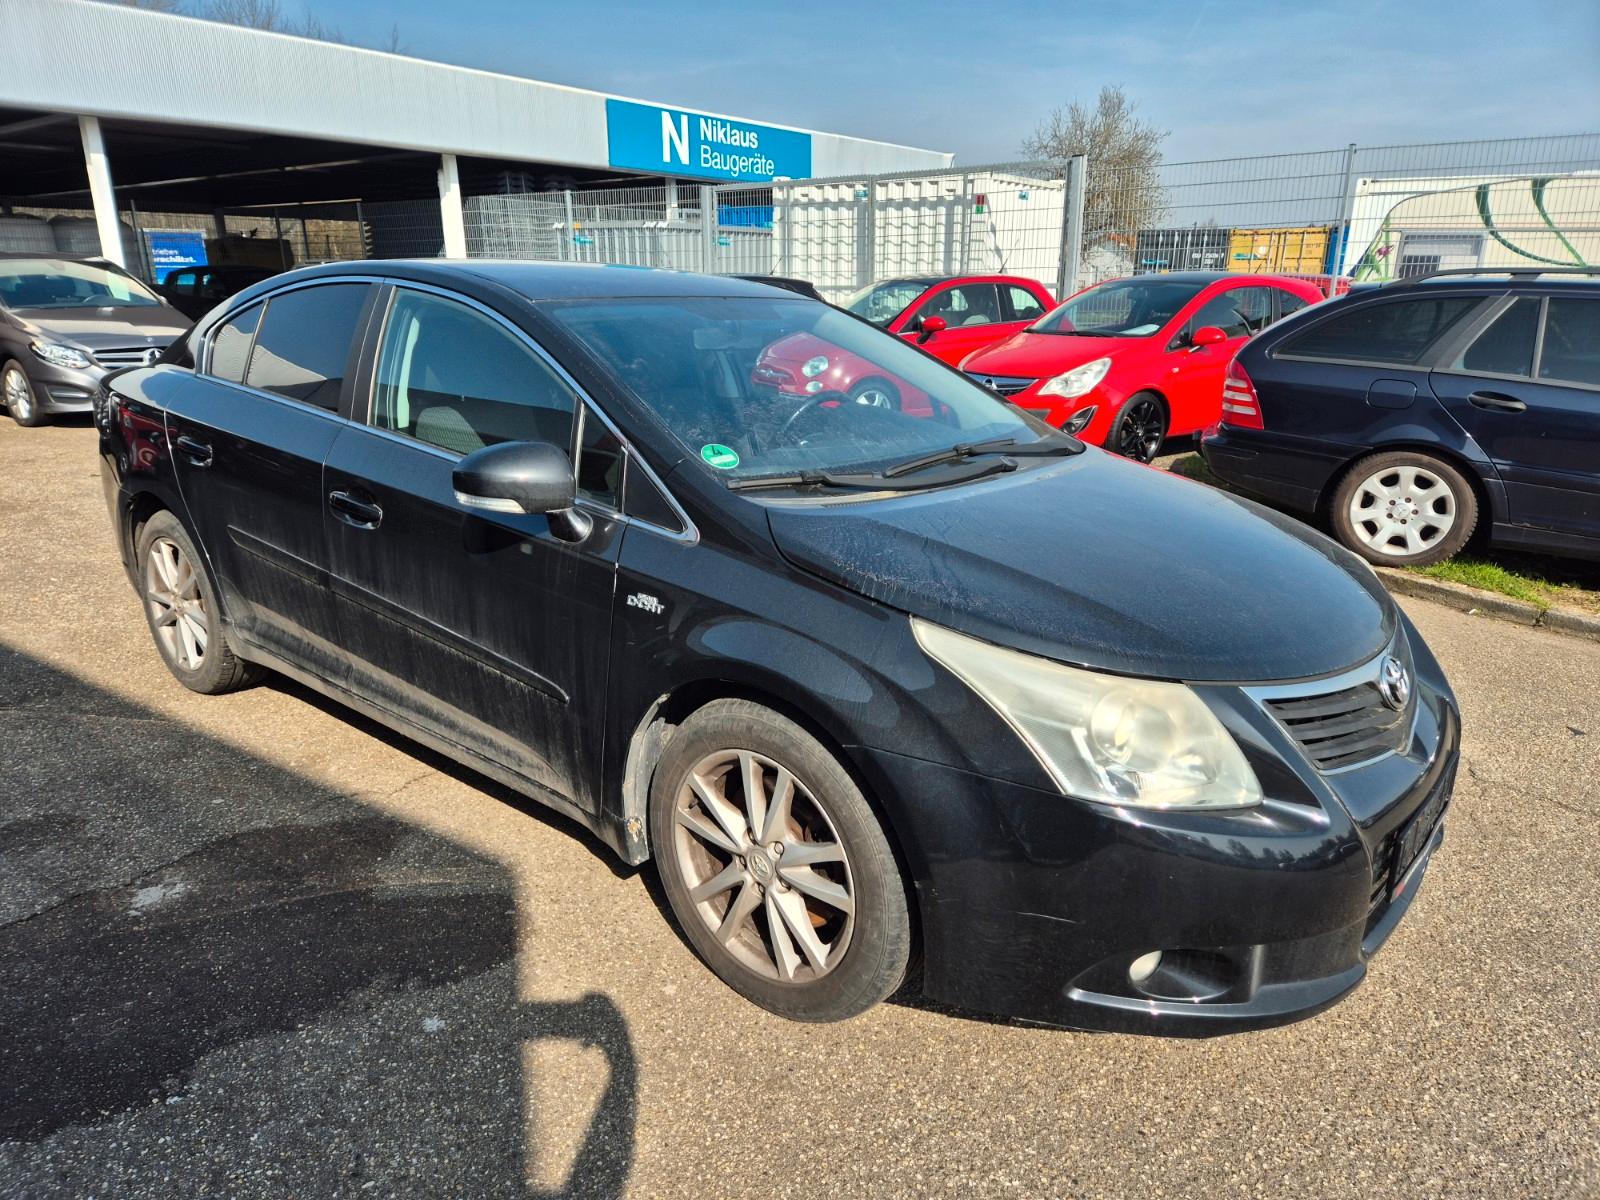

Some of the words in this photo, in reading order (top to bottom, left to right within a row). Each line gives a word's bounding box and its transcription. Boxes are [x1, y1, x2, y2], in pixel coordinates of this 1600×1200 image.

[661, 110, 690, 165] N
[700, 117, 759, 149] Niklaus
[701, 144, 775, 177] Baugeräte
[711, 445, 723, 456] 4
